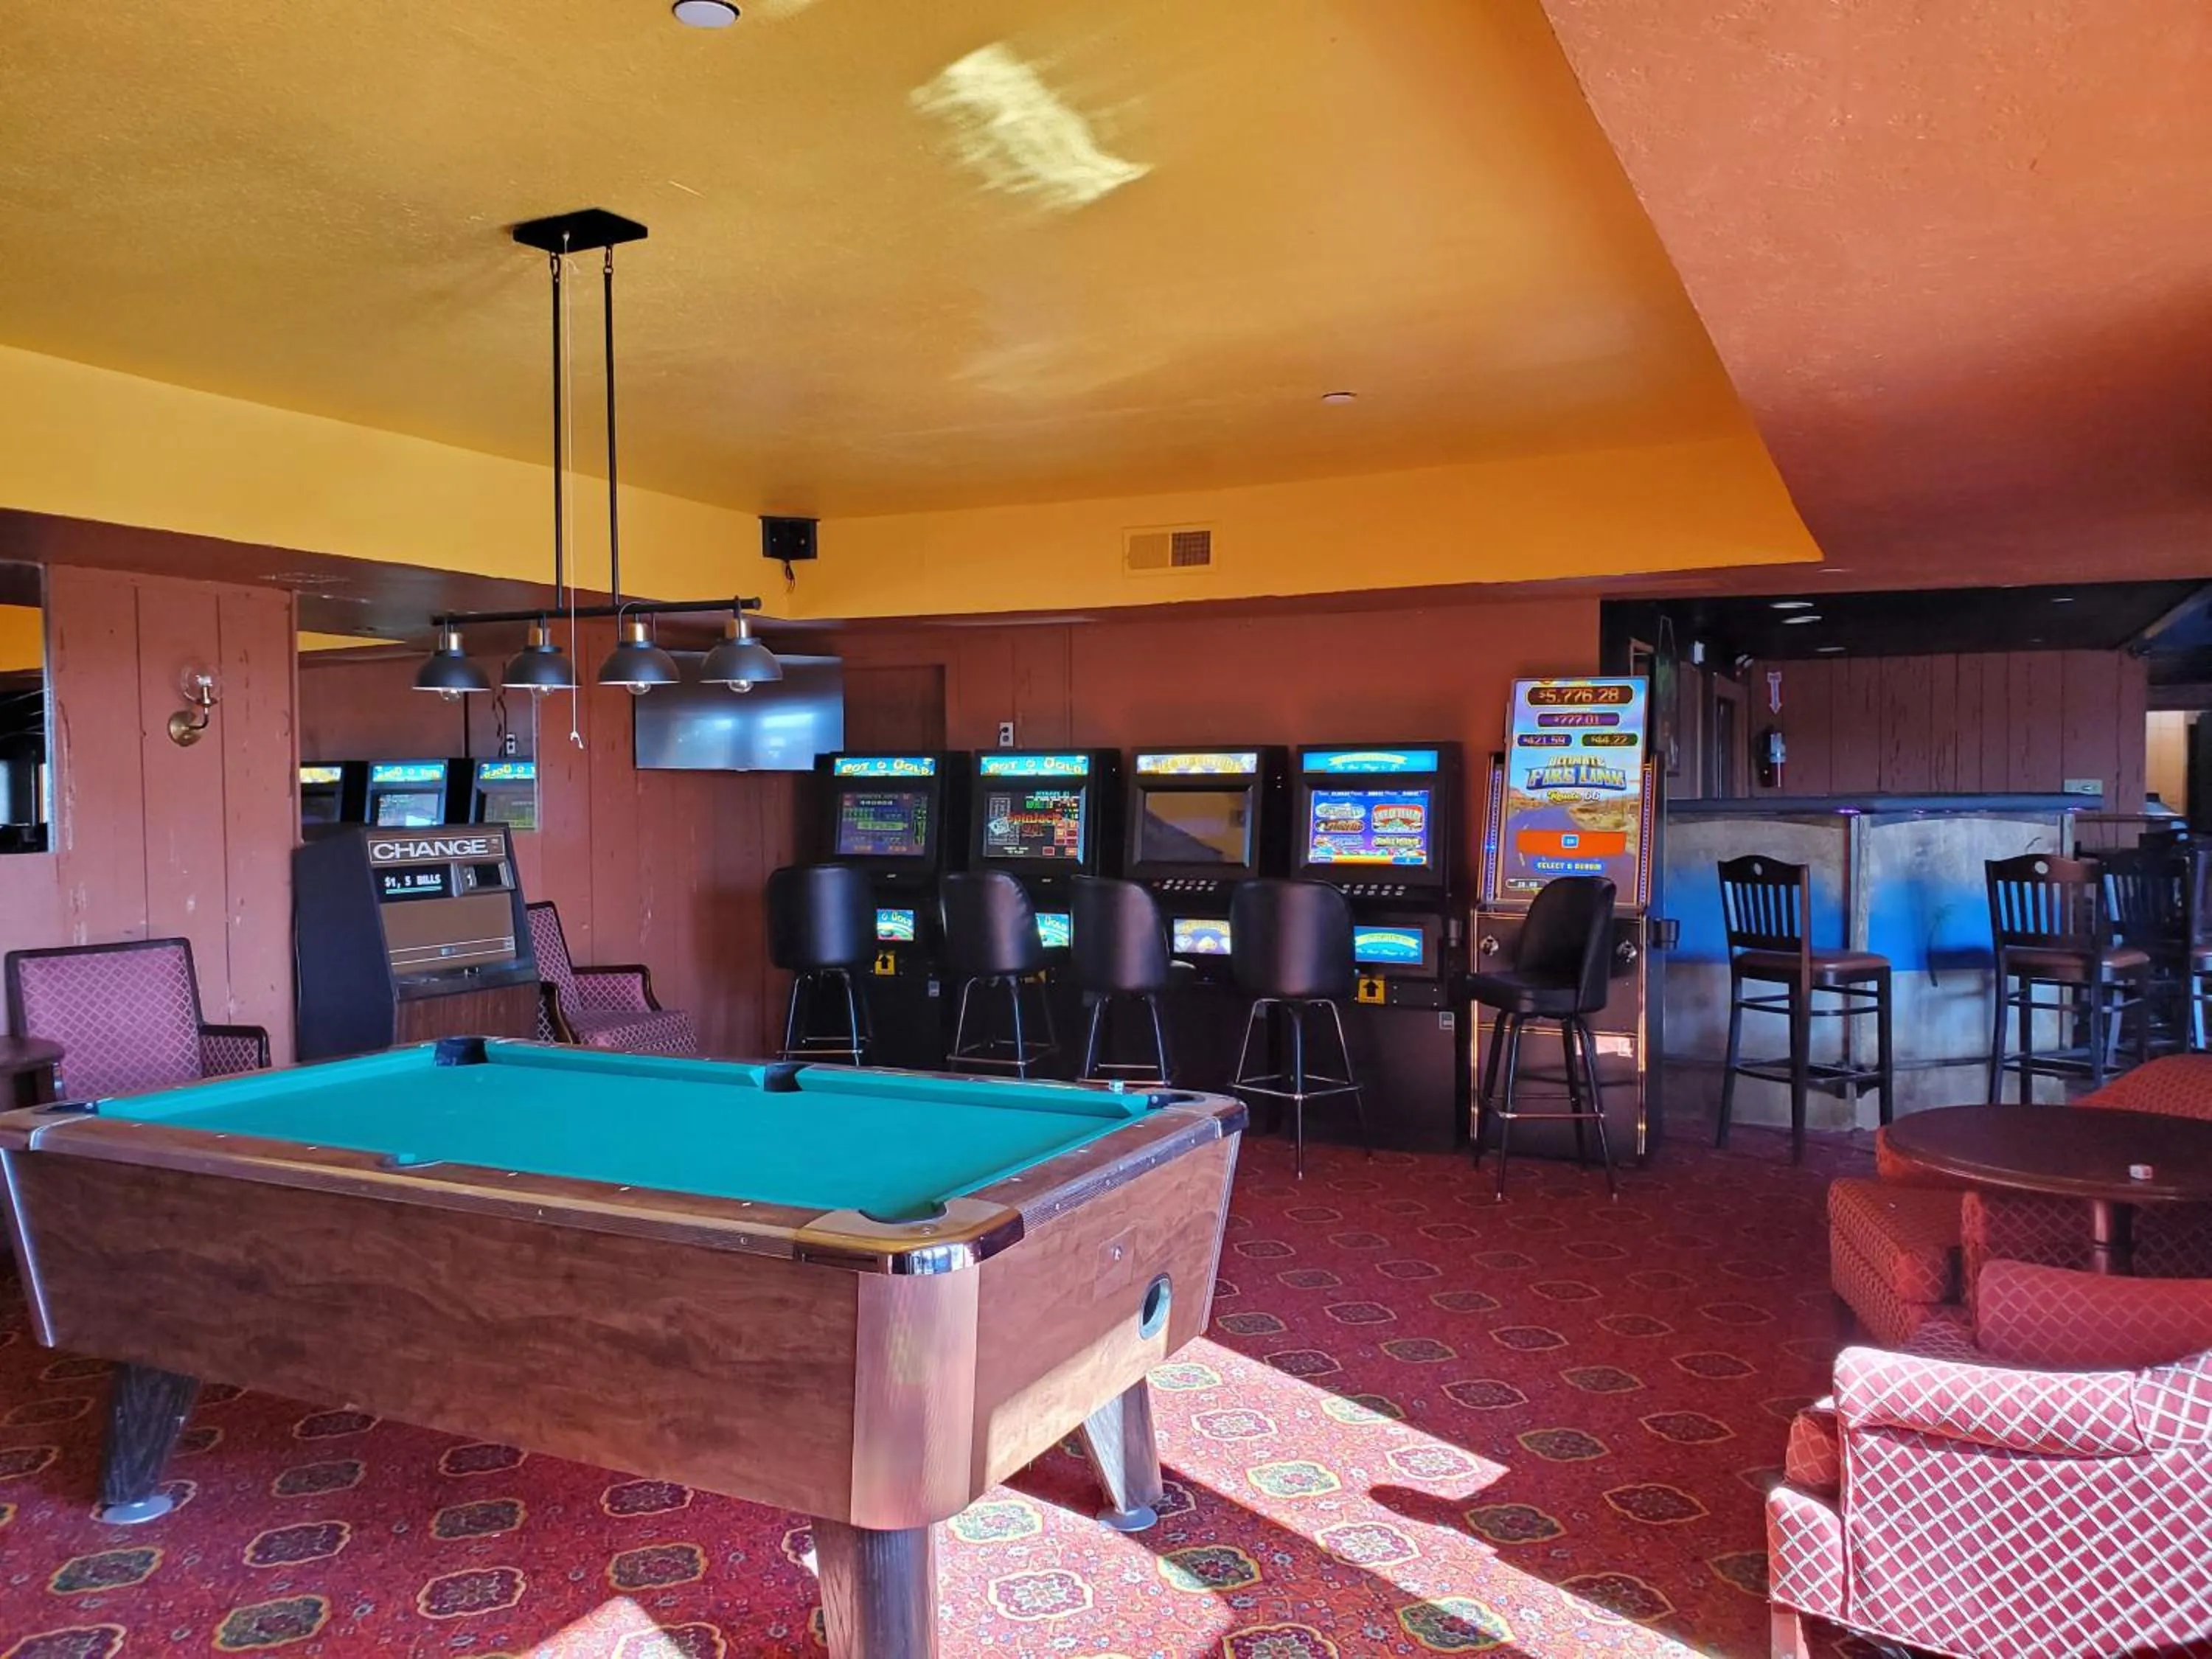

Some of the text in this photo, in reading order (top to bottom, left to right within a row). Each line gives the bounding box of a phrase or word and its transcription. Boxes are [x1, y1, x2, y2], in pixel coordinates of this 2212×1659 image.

[373, 838, 488, 859] CHANGE
[404, 875, 411, 886] 5
[417, 874, 442, 886] BILLS
